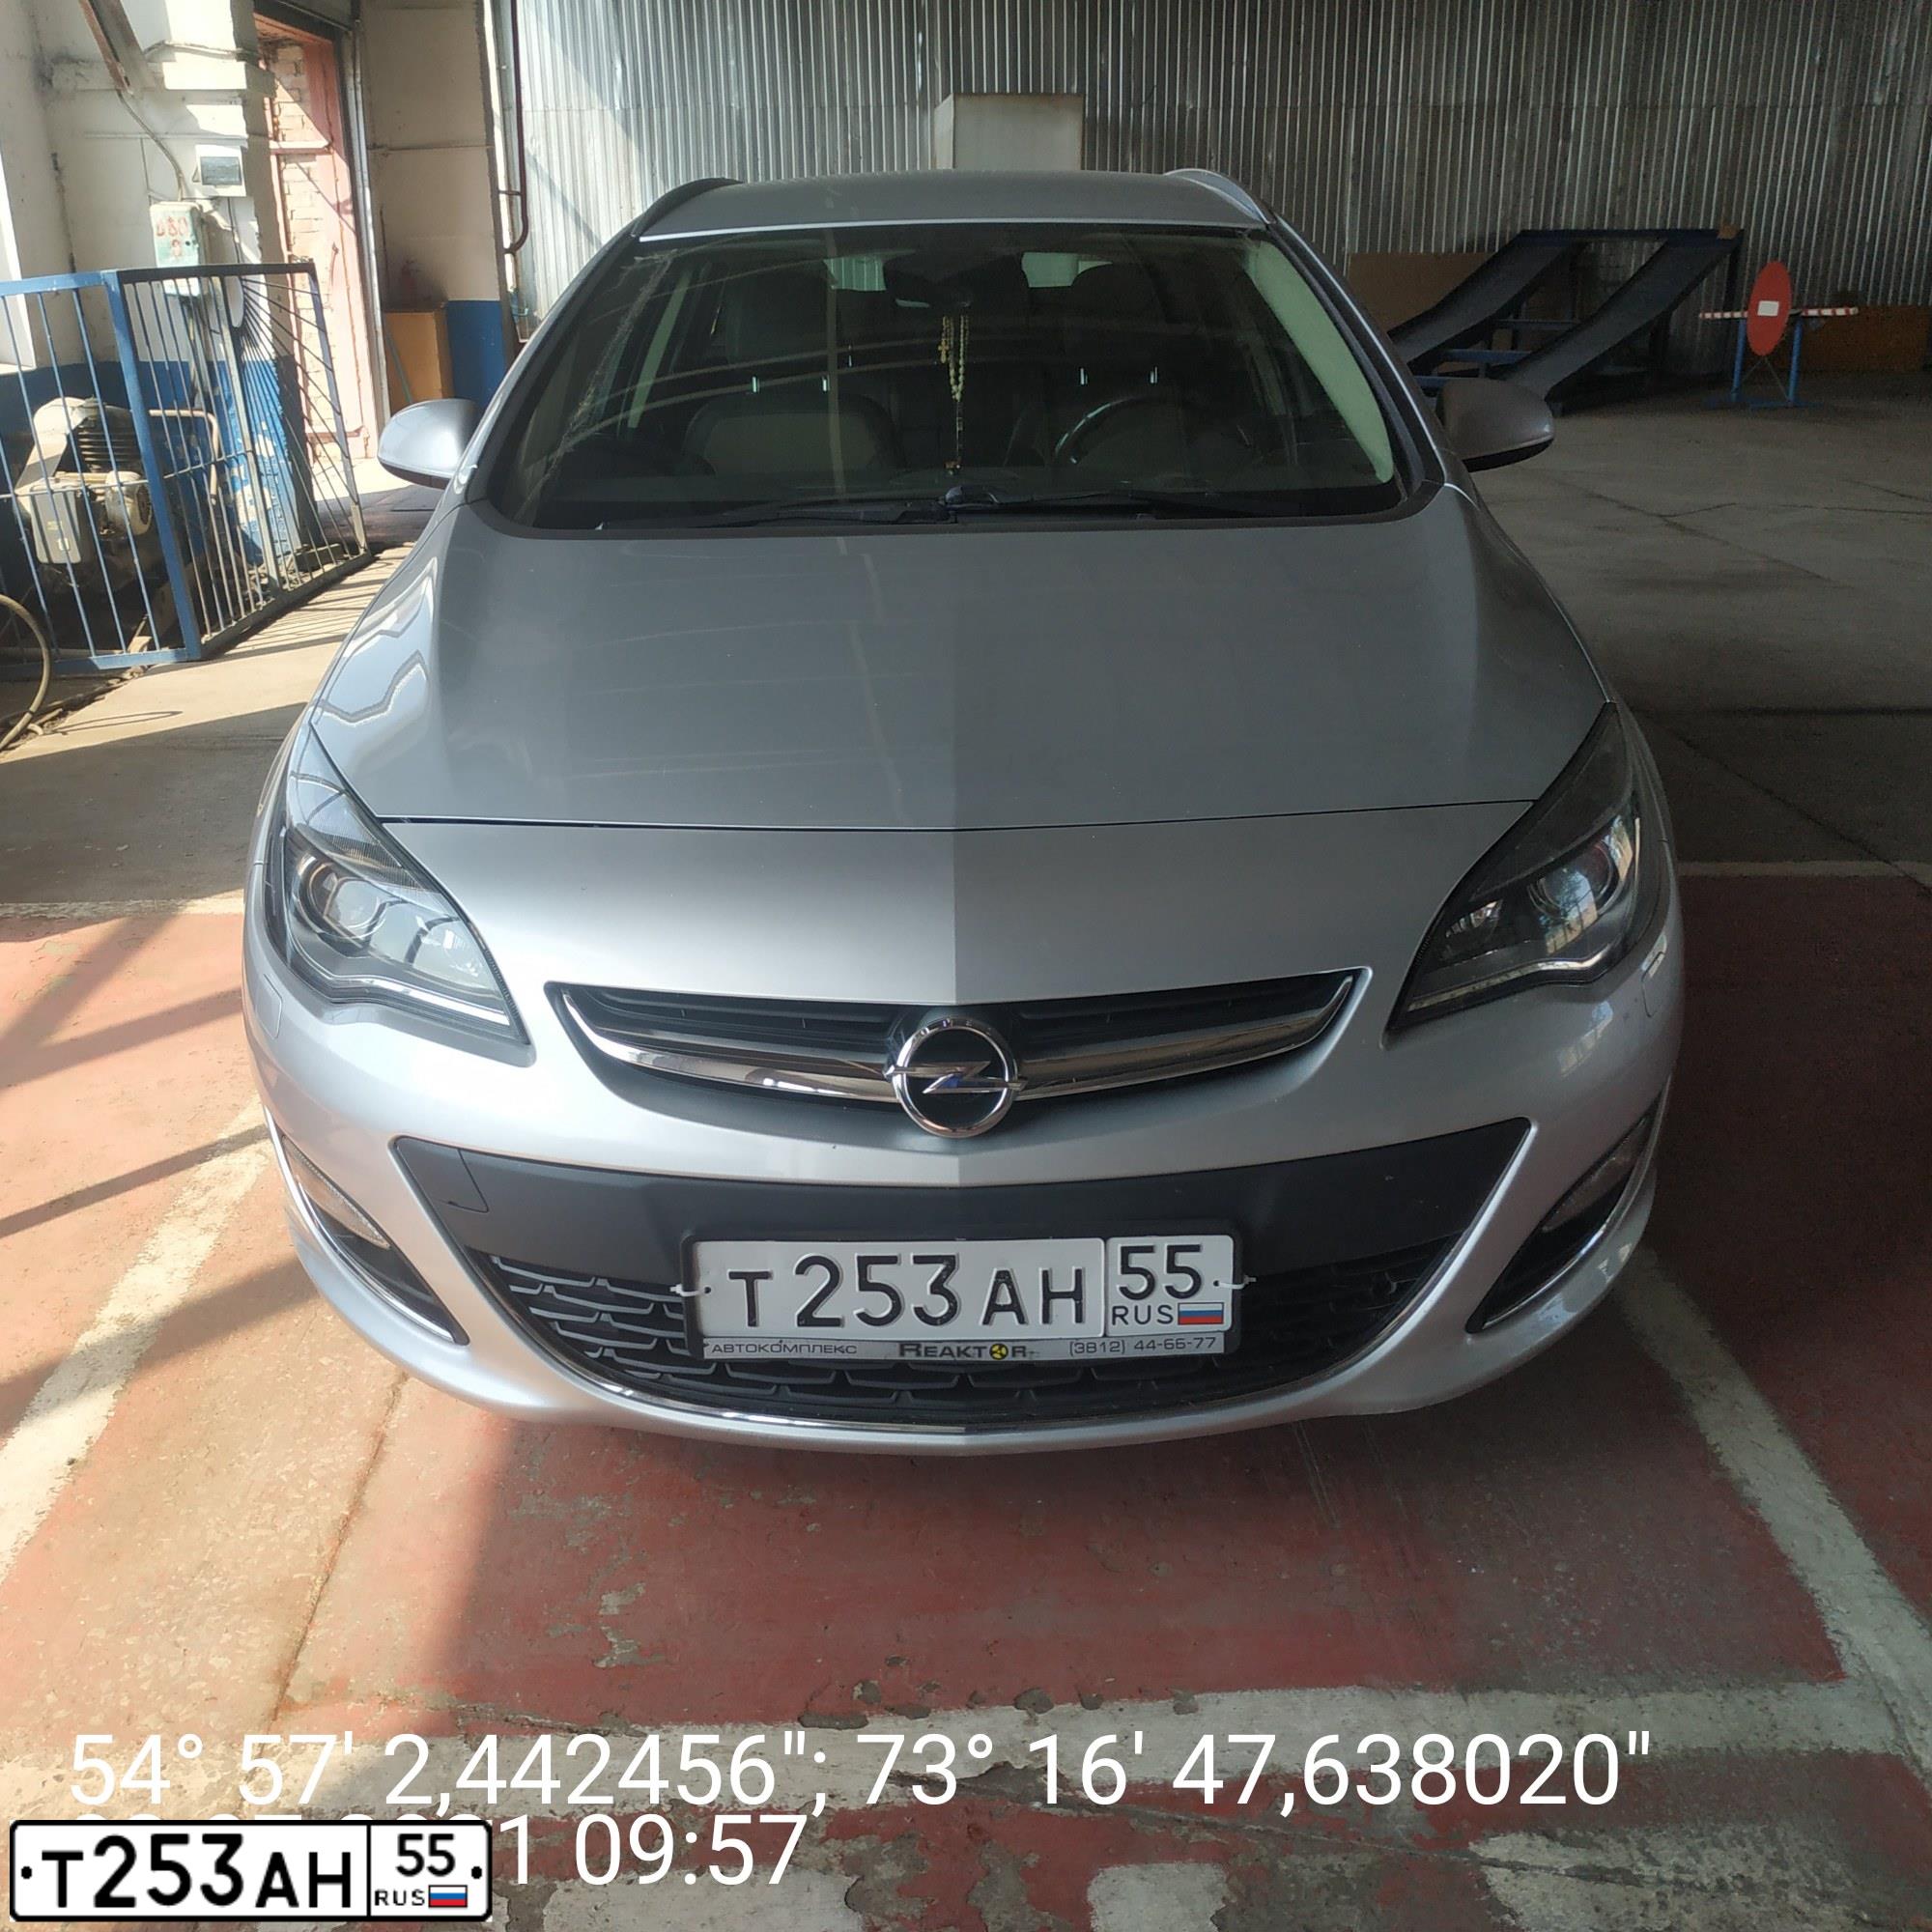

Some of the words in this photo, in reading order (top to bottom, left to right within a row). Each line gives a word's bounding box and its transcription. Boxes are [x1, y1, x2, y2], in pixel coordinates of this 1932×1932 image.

[1118, 1243, 1204, 1301] 55
[1111, 1304, 1174, 1326] RUS
[711, 1342, 858, 1355] АВТОКОМПЛЕКС
[1068, 1340, 1125, 1356] (3812)
